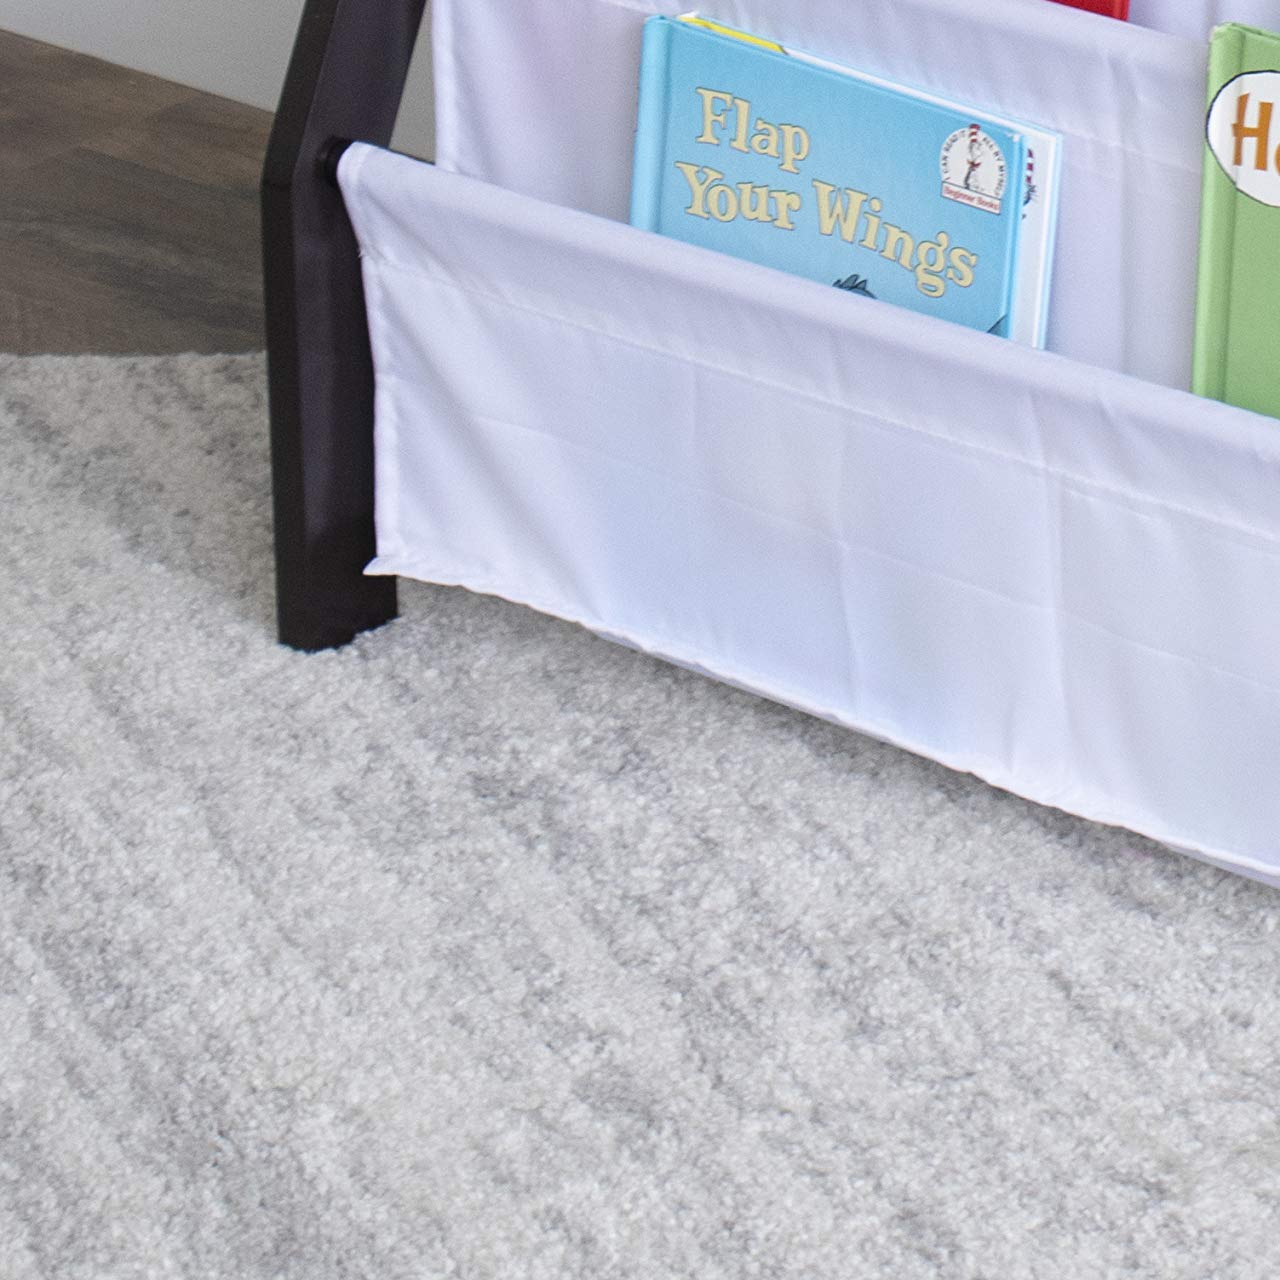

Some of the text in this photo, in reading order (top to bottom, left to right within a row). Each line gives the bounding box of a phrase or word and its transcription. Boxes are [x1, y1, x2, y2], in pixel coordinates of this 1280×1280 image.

[695, 86, 810, 173] Flap
[674, 161, 977, 298] Your Wings
